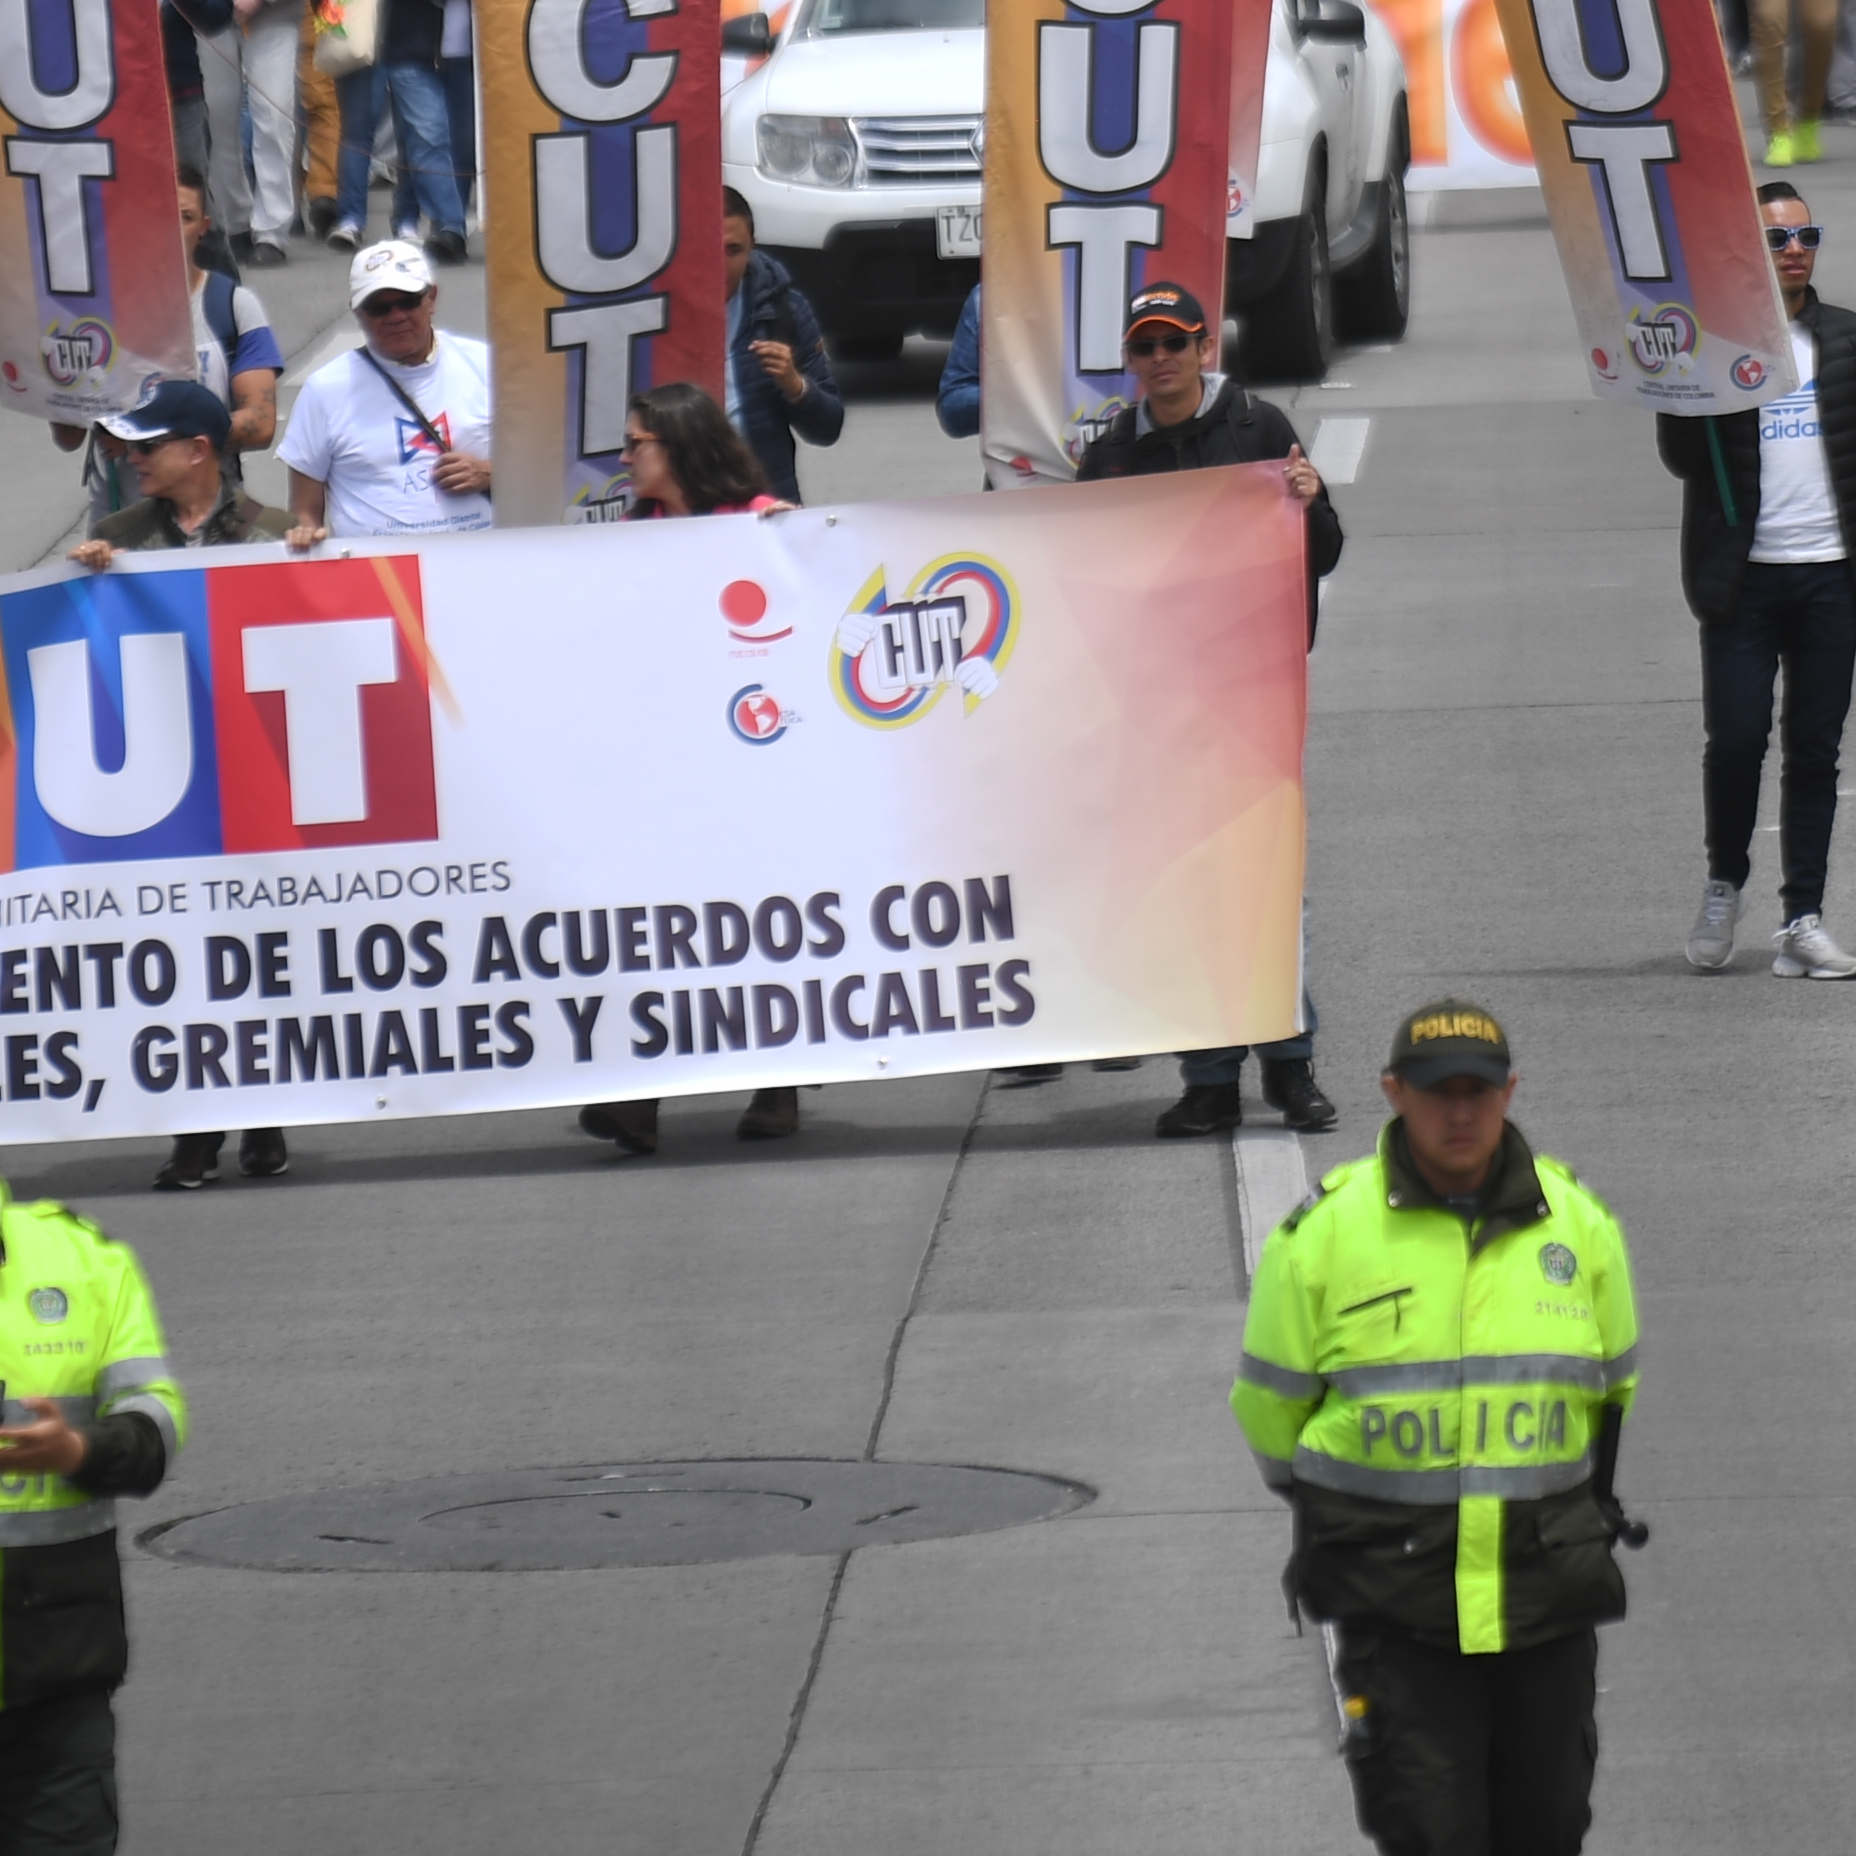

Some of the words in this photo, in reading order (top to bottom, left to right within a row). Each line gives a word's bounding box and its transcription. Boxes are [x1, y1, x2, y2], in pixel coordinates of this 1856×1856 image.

[386, 516, 449, 530] Universidad
[136, 883, 189, 916] DE
[206, 859, 512, 912] TRABAJADORES
[204, 931, 293, 1003] DE
[317, 918, 448, 997] LOS
[471, 890, 846, 985] ACUERDOS
[868, 873, 1015, 954] CON
[128, 998, 536, 1097] GREMIALES
[555, 994, 605, 1064] Y
[628, 957, 1038, 1061] SINDICALES
[1409, 1008, 1499, 1046] POLICIA
[1357, 1399, 1567, 1460] POLICIA
